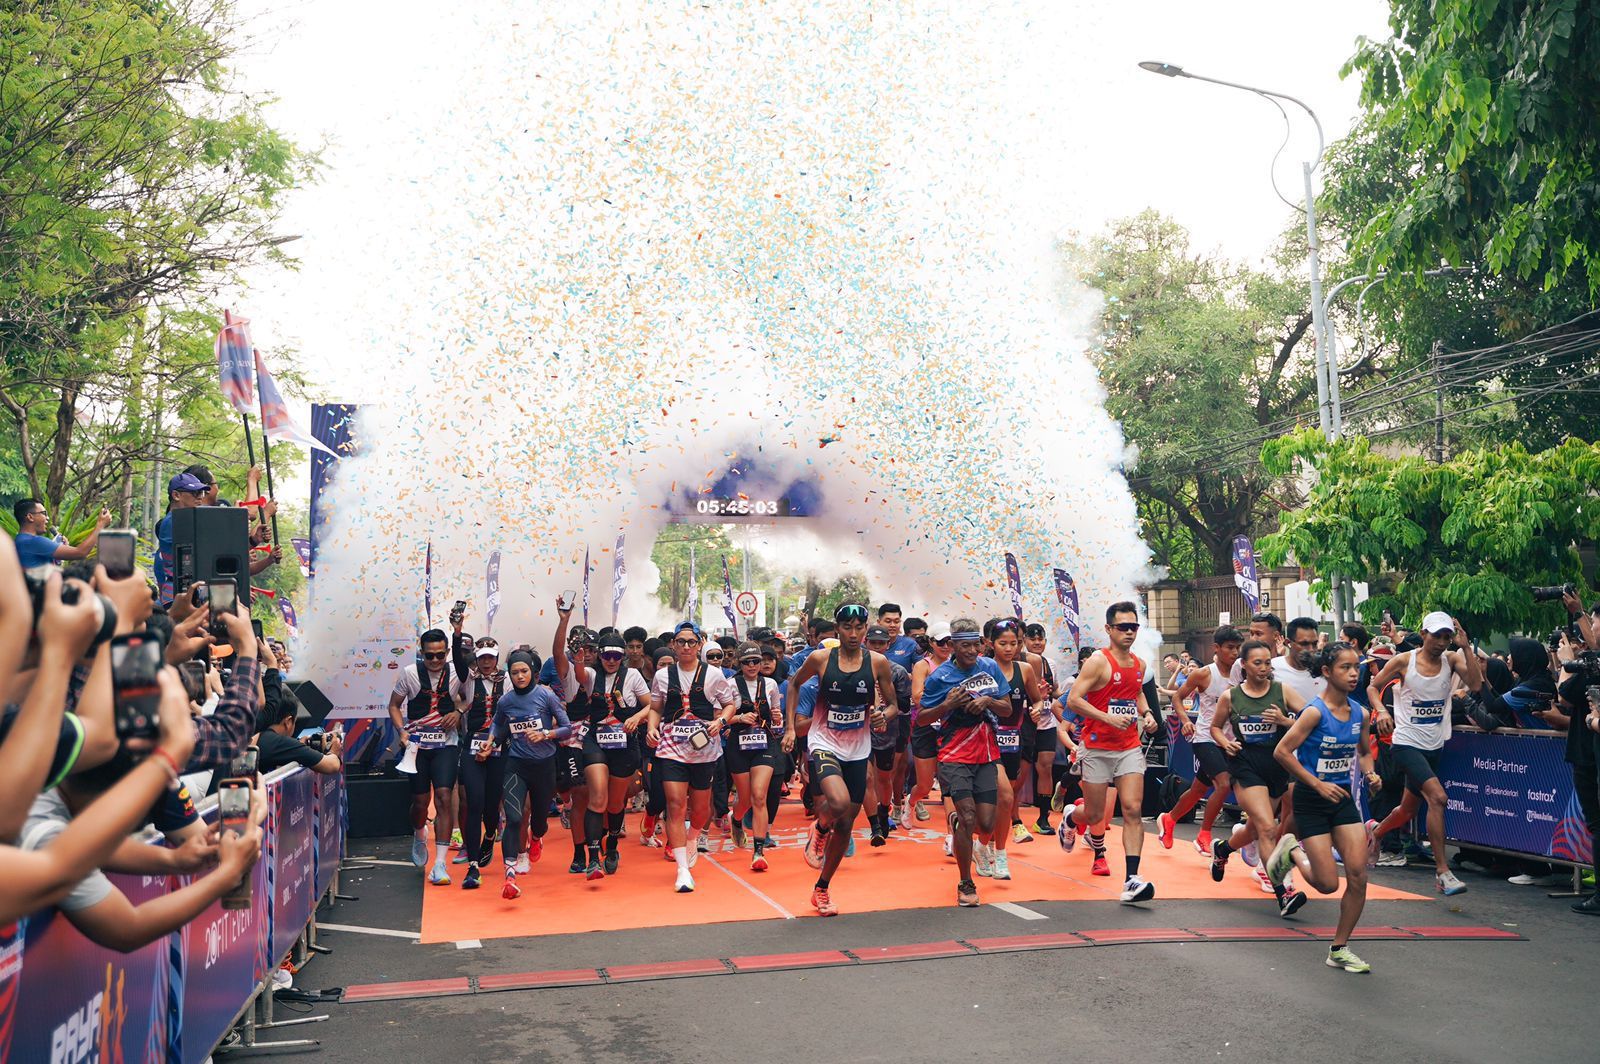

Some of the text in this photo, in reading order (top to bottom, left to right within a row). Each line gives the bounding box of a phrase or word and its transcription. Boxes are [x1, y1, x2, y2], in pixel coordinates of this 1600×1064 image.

[697, 500, 778, 514] 05:45:03
[741, 600, 750, 612] 10
[965, 678, 993, 690] 10043
[1111, 707, 1135, 715] 10040
[832, 713, 861, 721] 10238
[513, 720, 538, 731] 10345
[1242, 723, 1272, 732] 10027
[419, 732, 443, 740] PACER
[742, 734, 765, 742] PACER
[1324, 759, 1349, 769] 10374
[1473, 757, 1528, 774] Media Partner
[1528, 789, 1556, 803] fastrax
[205, 911, 229, 970] 20FIT
